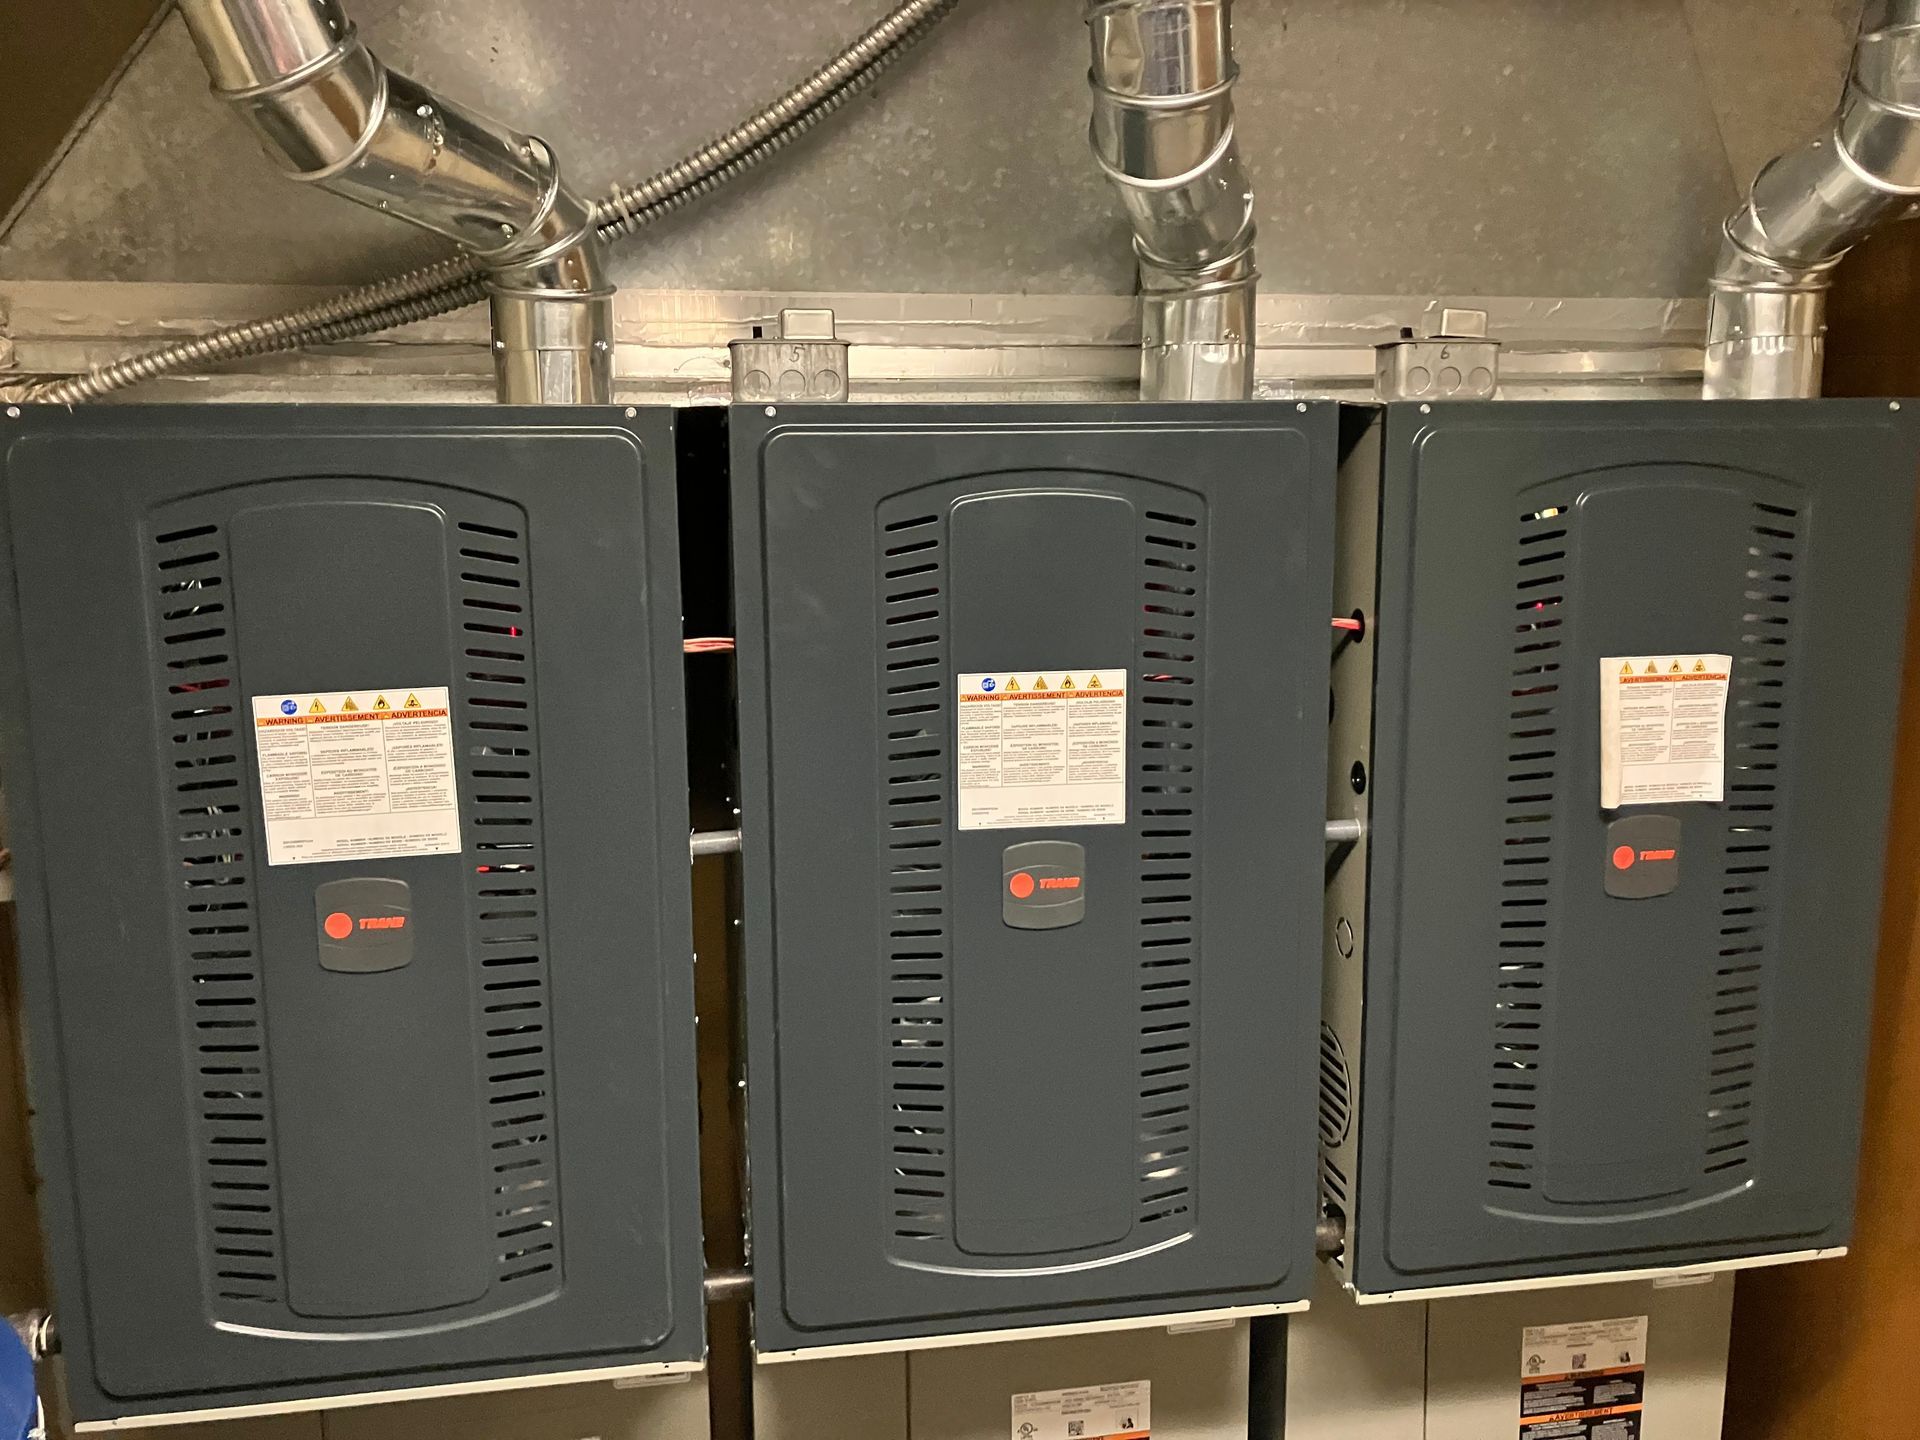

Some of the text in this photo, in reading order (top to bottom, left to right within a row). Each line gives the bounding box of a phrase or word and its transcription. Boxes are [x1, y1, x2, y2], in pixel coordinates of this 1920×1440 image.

[788, 343, 805, 363] 5
[1440, 345, 1449, 359] 6
[1009, 692, 1066, 700] AVERTISSEMENT
[1075, 690, 1124, 698] ADVERTENCIA
[265, 709, 447, 726] WARNING AVERTISSEMENT ADVERTENCIA
